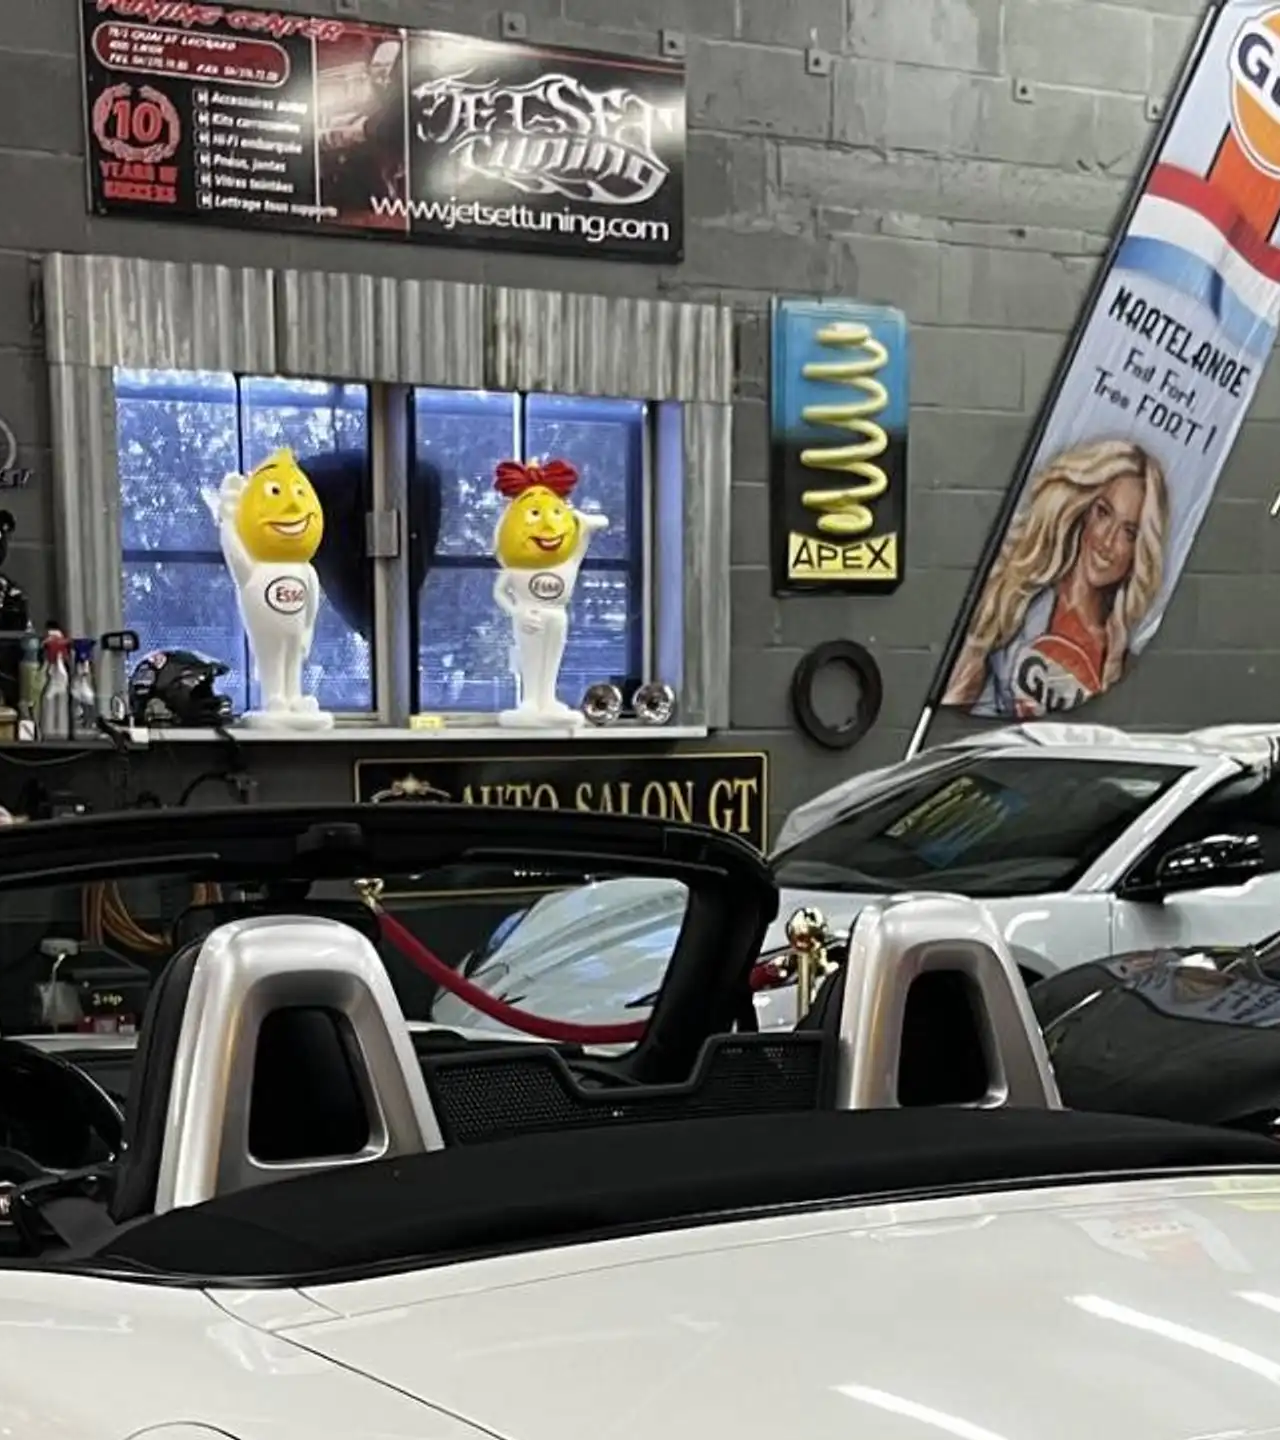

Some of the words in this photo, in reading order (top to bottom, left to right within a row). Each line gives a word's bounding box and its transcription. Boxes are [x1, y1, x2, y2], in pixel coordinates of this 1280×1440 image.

[113, 99, 163, 143] 10
[792, 538, 892, 570] APEX
[707, 778, 758, 834] GT
